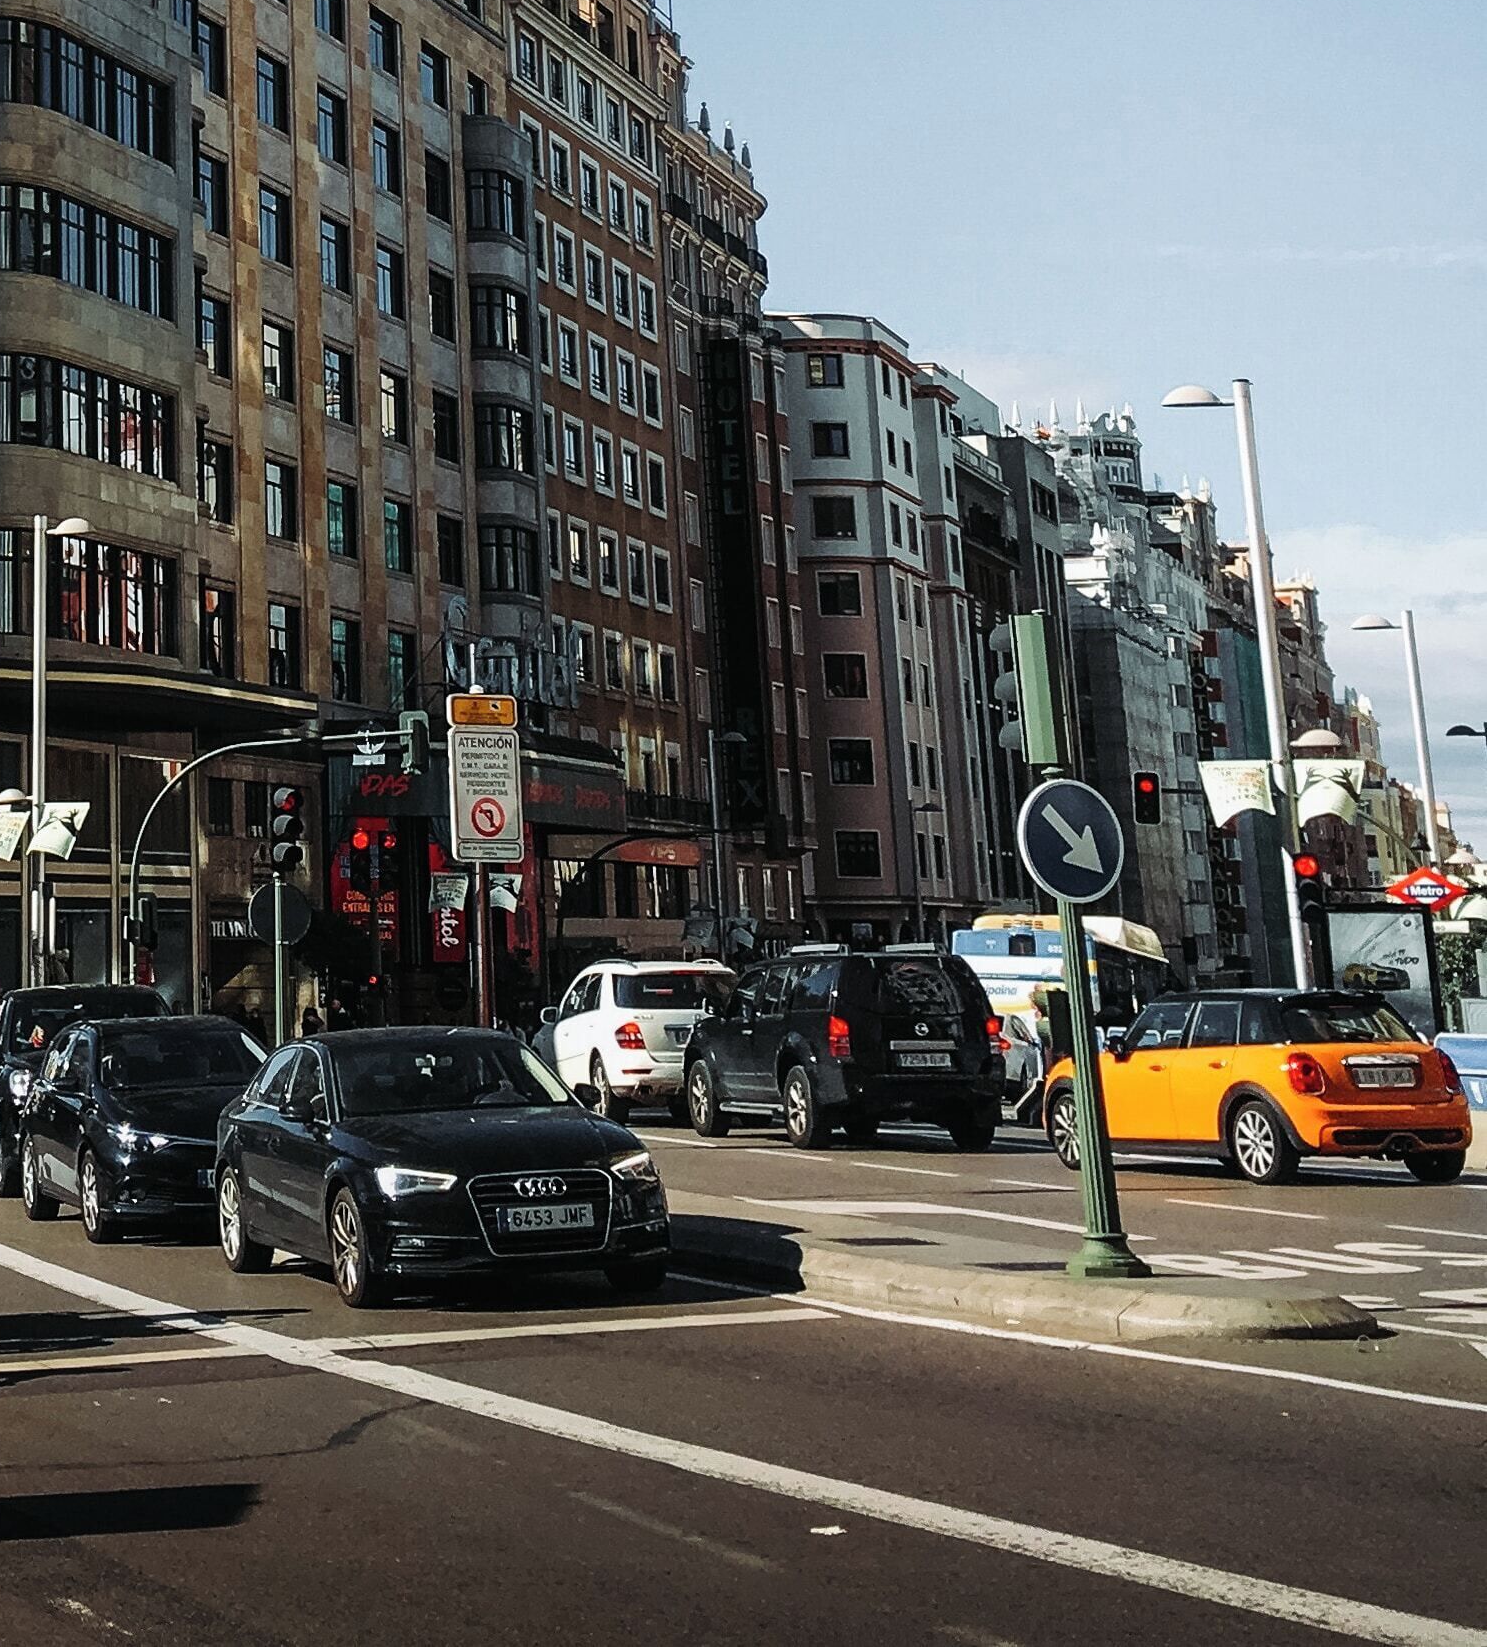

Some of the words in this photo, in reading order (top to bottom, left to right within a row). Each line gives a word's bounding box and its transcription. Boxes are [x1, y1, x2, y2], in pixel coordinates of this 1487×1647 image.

[458, 735, 512, 750] ATENCIÓN
[1410, 885, 1444, 896] Metro
[513, 1209, 553, 1227] 6453
[559, 1206, 587, 1224] JMF
